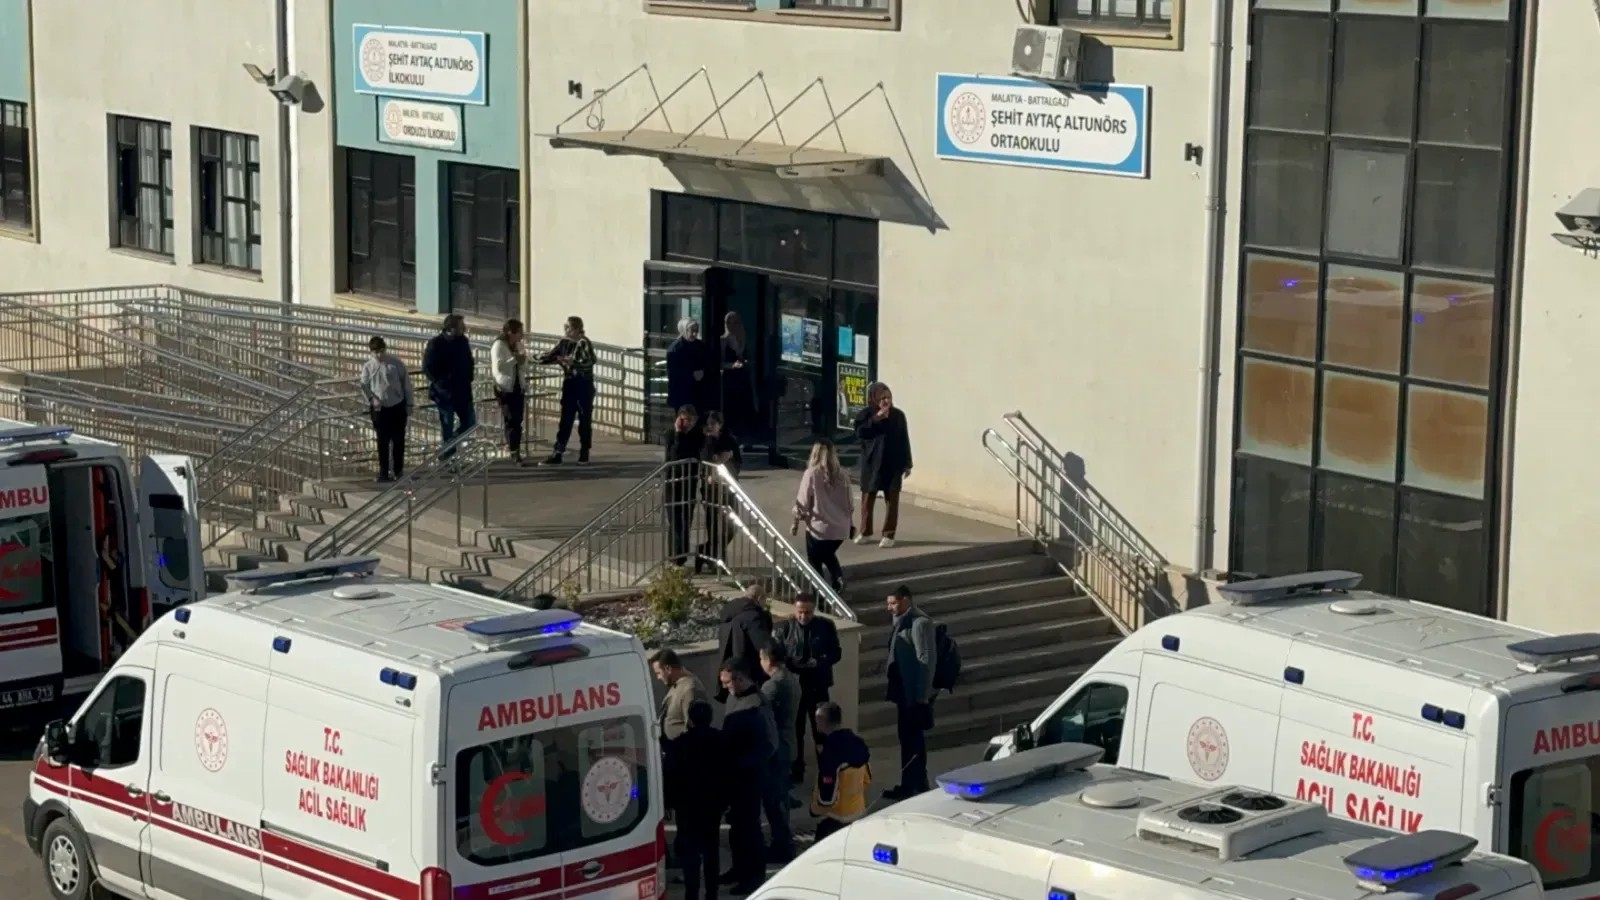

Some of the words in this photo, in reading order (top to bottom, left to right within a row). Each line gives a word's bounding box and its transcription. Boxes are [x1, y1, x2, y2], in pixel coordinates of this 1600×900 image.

[389, 52, 408, 67] ŞEHİT
[410, 55, 433, 71] AYTAÇ
[434, 56, 474, 72] ALTUNÖRS
[389, 69, 424, 86] İLKOKULU
[991, 93, 1022, 104] MALATYA
[991, 108, 1023, 128] ŞEHİT
[1026, 113, 1061, 133] AYTAÇ
[1064, 111, 1127, 134] ALTUNÖRS
[991, 133, 1060, 152] ORTAOKULU
[478, 682, 621, 731] AMBULANS
[324, 728, 343, 755] T.C.
[1352, 712, 1375, 744] T.C.
[1533, 720, 1600, 755] AMBU
[285, 750, 319, 783] SAĞLIK
[322, 761, 379, 800] BAKANLIĞI
[1300, 740, 1347, 776] SAĞLIK
[1349, 755, 1421, 798] BAKANLIĞI
[171, 802, 261, 849] AMBULANS
[299, 788, 323, 817] ACİL
[326, 796, 367, 832] SAĞLIK
